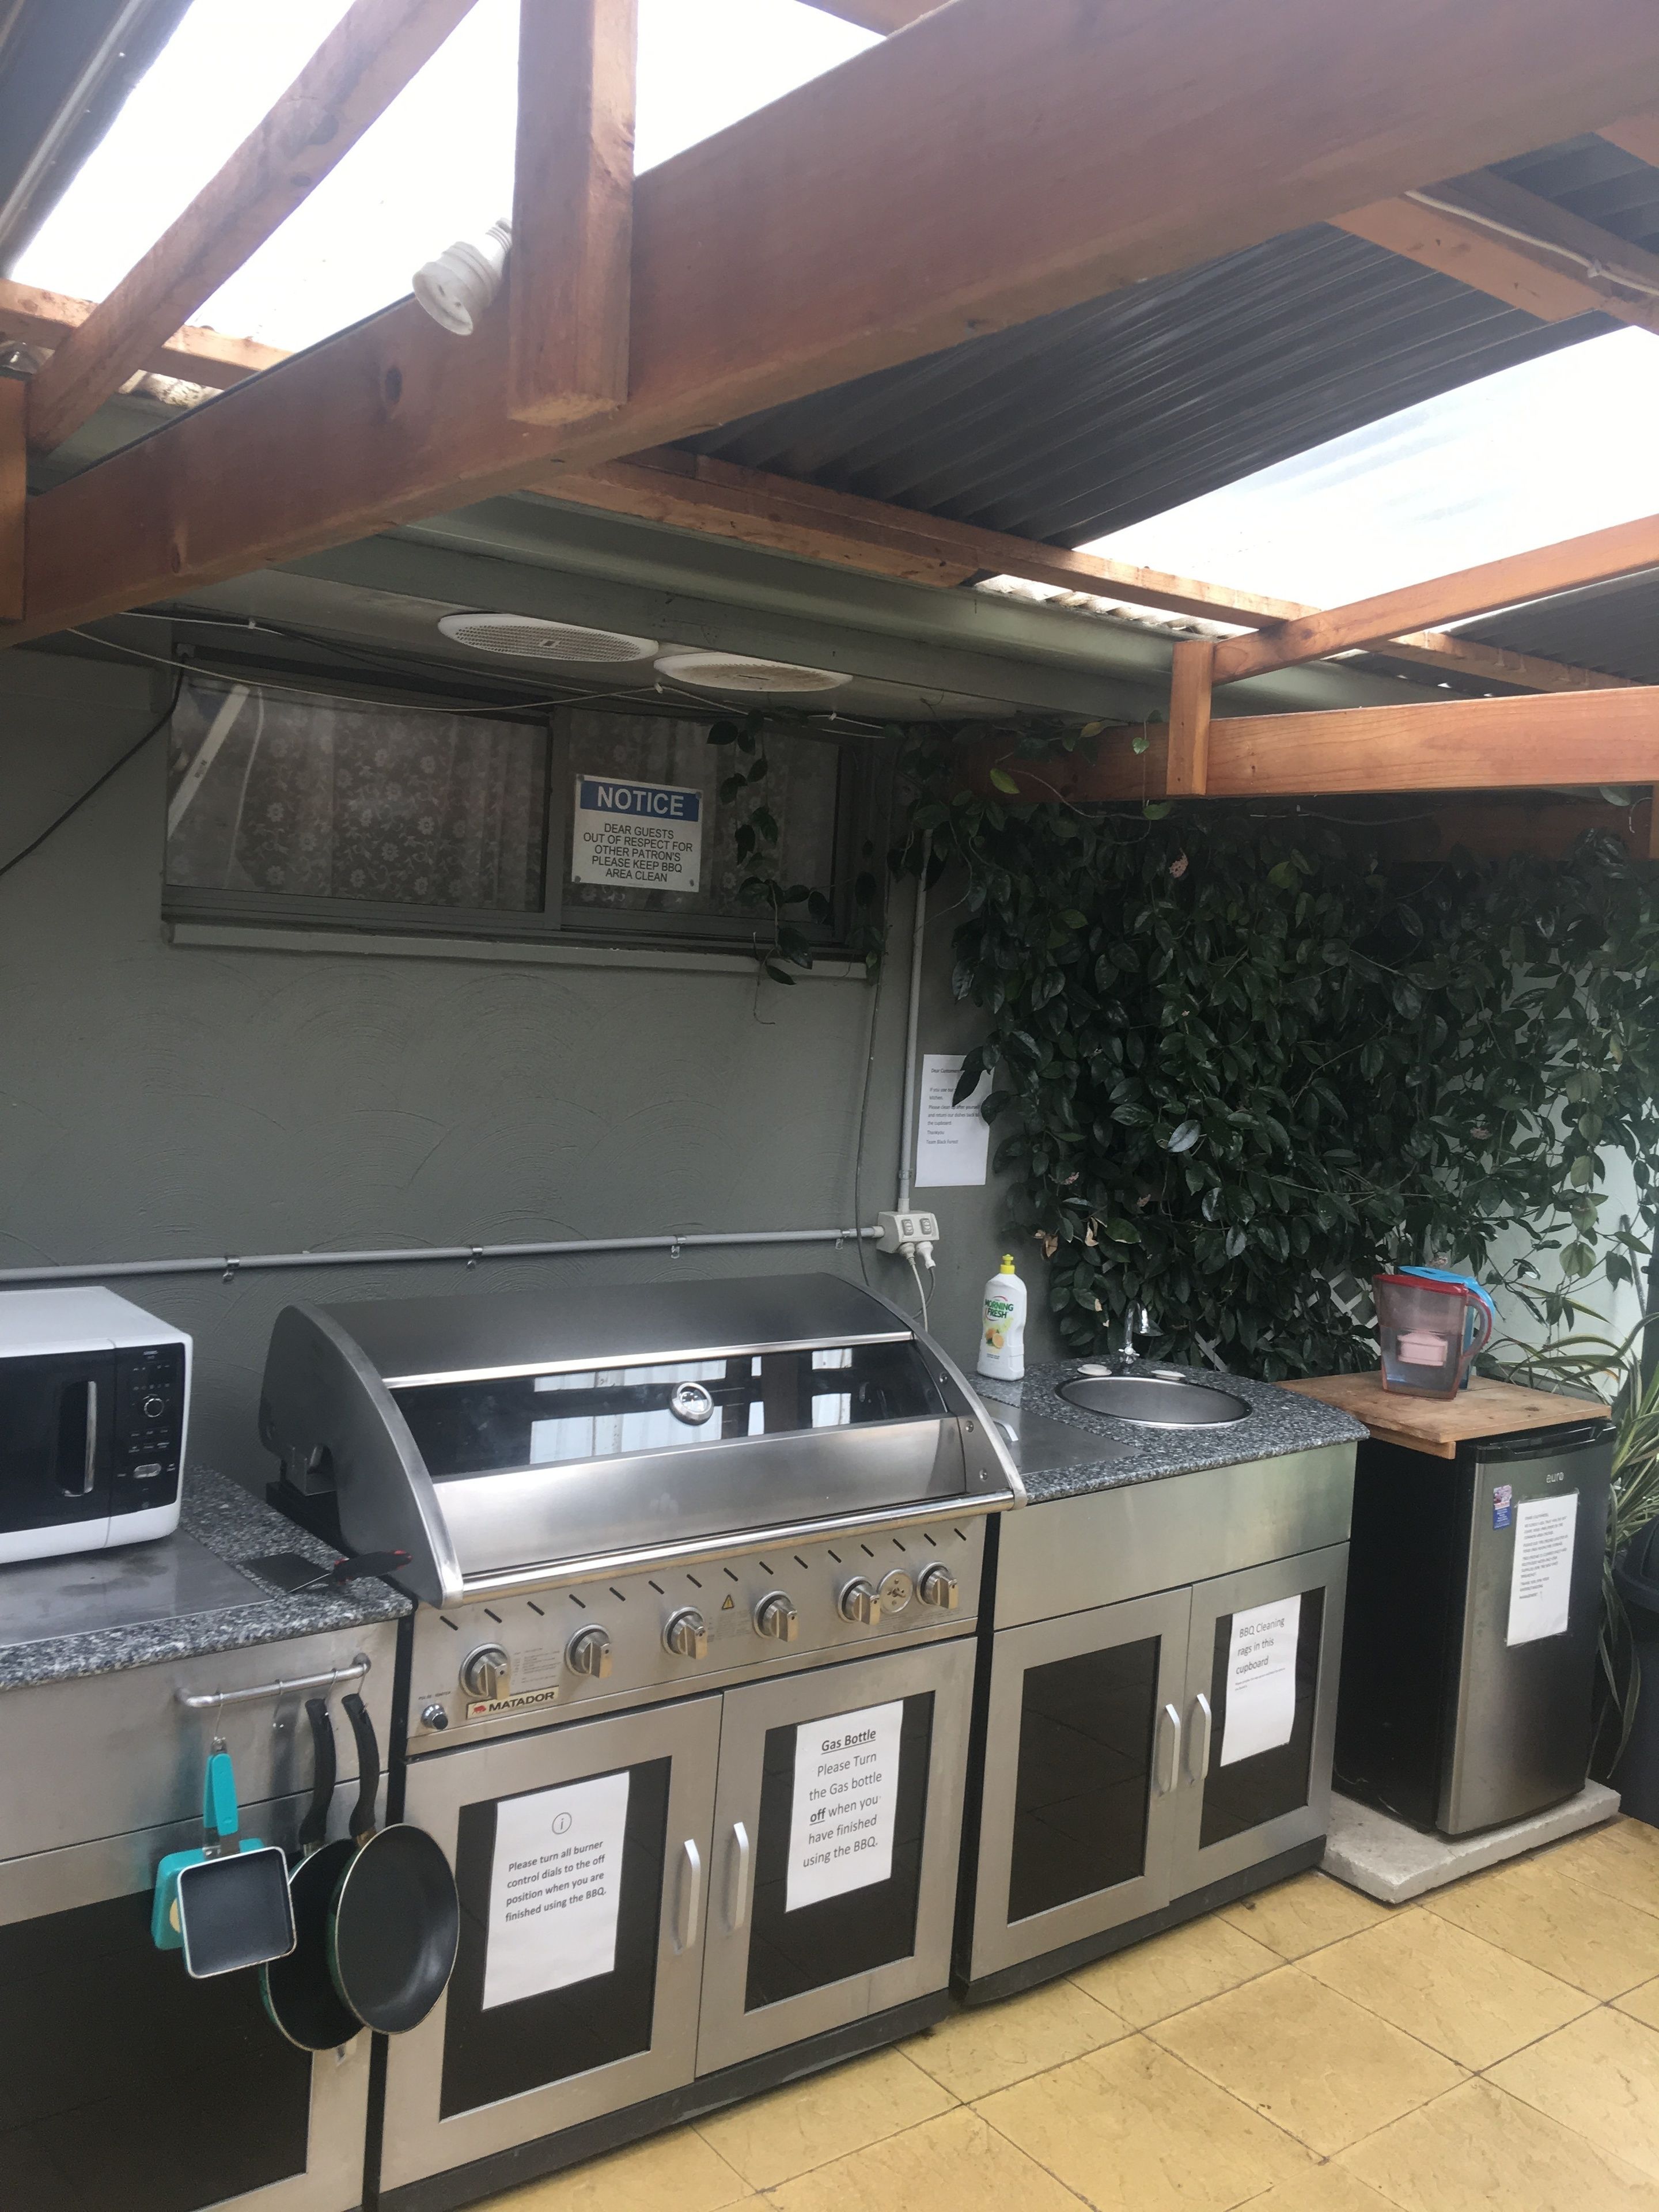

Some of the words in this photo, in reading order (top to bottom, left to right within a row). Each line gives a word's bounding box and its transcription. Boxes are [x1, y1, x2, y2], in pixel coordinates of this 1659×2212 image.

[597, 786, 684, 816] NOTICE
[584, 832, 605, 843] OUT
[608, 835, 621, 844] OF
[624, 837, 670, 850] RESPECT
[673, 842, 693, 852] FOR
[604, 823, 631, 835] DEAR
[634, 827, 674, 839] GUESTS
[592, 855, 630, 868] PLEASE
[633, 860, 659, 870] KEEP
[662, 863, 682, 873] BBQ
[594, 845, 629, 857] OTHER
[632, 849, 680, 861] PATRON'S
[605, 868, 632, 880] AREA
[635, 871, 668, 882] CLEAN
[985, 1299, 1014, 1312] MORNING
[987, 1308, 1008, 1319] FRESH
[1239, 1624, 1255, 1638] BBQ
[1256, 1617, 1285, 1633] Cleaning
[1237, 1645, 1252, 1657] rags
[1253, 1642, 1260, 1652] in
[1262, 1637, 1275, 1650] this
[1236, 1656, 1269, 1675] cupboard
[488, 1691, 555, 1713] MATADOR
[821, 1737, 842, 1753] Gas
[844, 1728, 876, 1747] Bottle
[817, 1759, 850, 1778] Please
[853, 1752, 877, 1768] Turn
[809, 1786, 827, 1802] the
[829, 1782, 849, 1796] Gas
[851, 1771, 882, 1790] bottle
[810, 1808, 825, 1823] off
[828, 1801, 857, 1818] when
[859, 1795, 878, 1812] you
[808, 1828, 834, 1845] have
[836, 1814, 877, 1837] finished
[508, 1858, 537, 1873] Please
[540, 1852, 558, 1864] turn
[560, 1847, 571, 1858] all
[574, 1840, 604, 1855] burner
[802, 1849, 831, 1868] using
[834, 1842, 851, 1857] the
[854, 1835, 878, 1852] BBQ.
[507, 1874, 540, 1889] control
[541, 1866, 562, 1880] dials
[565, 1864, 574, 1873] to
[576, 1859, 590, 1870] the
[593, 1854, 605, 1866] off
[506, 1889, 543, 1908] position
[546, 1882, 569, 1896] when
[571, 1877, 588, 1890] you
[590, 1872, 604, 1884] are
[505, 1905, 541, 1923] finished
[544, 1897, 567, 1914] using
[569, 1893, 584, 1904] the
[586, 1887, 607, 1900] BBQ.
